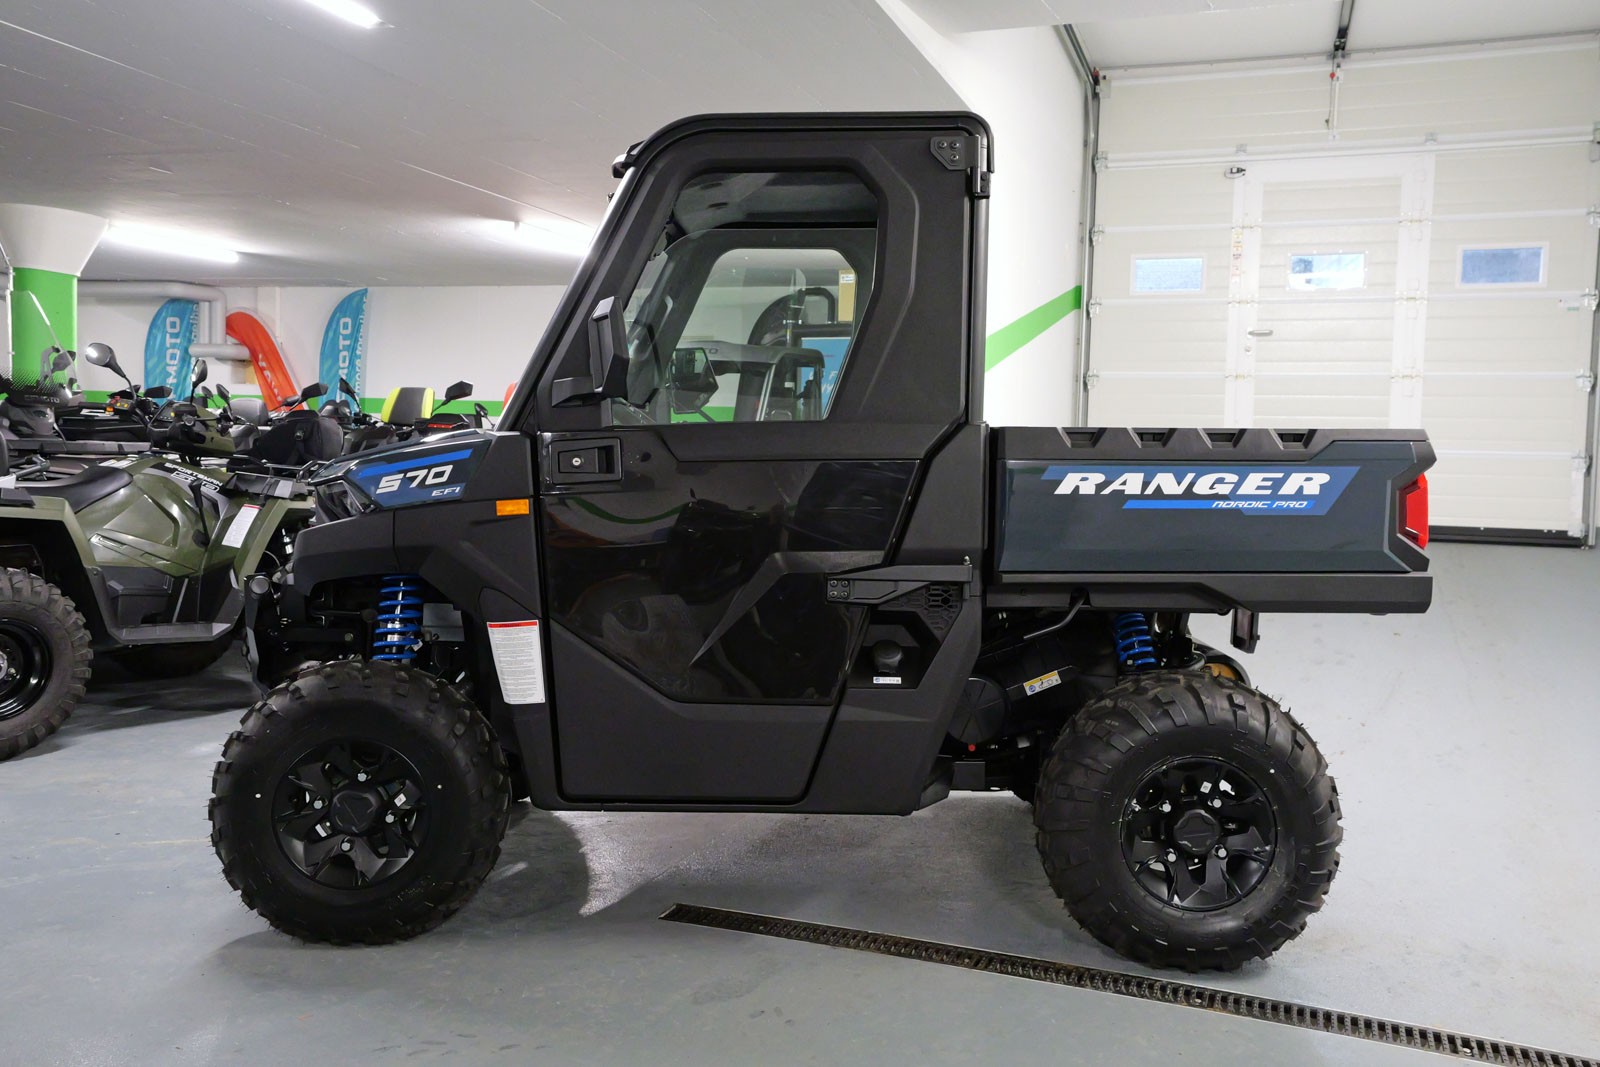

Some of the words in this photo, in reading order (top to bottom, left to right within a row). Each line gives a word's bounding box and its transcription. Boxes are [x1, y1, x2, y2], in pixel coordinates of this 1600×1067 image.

[164, 462, 223, 487] SPORTSMAN
[376, 464, 453, 494] 570
[1053, 472, 1331, 495] RANGER
[431, 486, 461, 497] EFI
[1212, 500, 1271, 508] NORDIC
[1272, 500, 1308, 508] PRO
